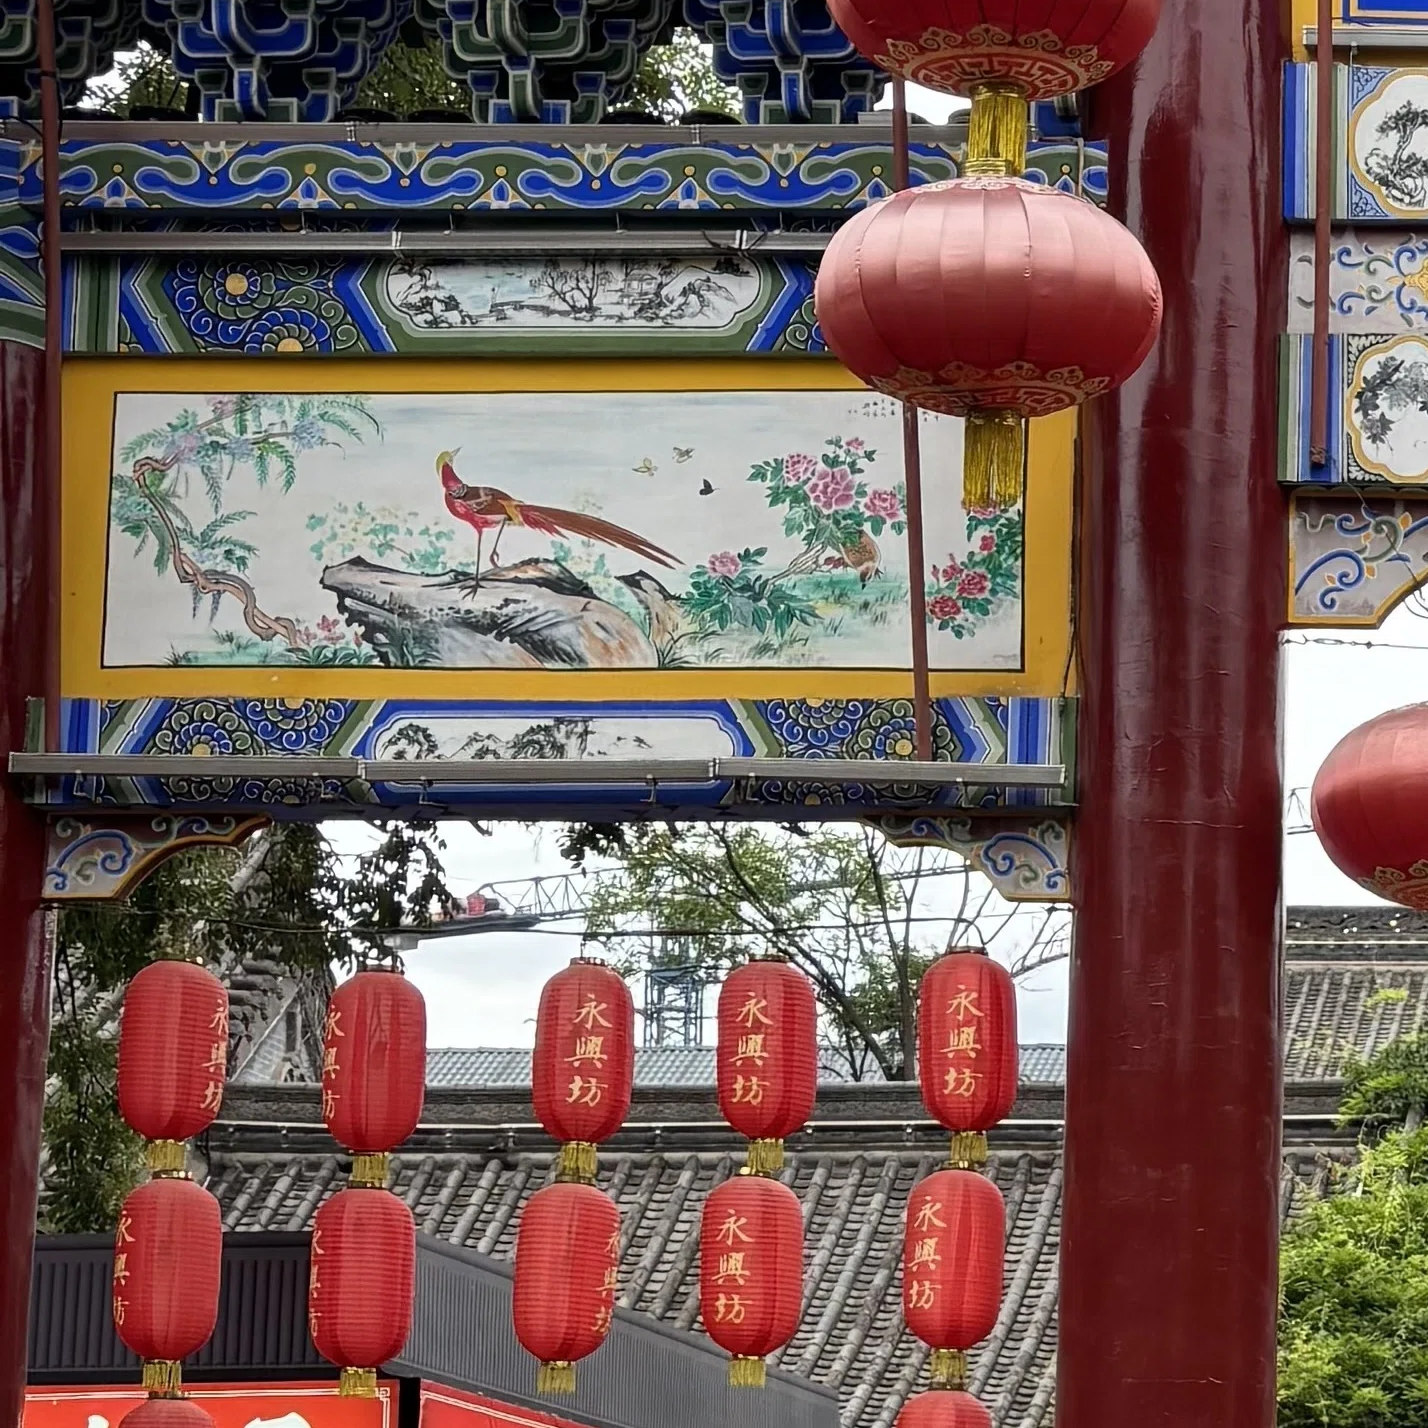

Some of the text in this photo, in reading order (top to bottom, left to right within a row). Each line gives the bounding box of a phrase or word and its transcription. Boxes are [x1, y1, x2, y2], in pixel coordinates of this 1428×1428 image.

[564, 993, 612, 1108] 永興坊
[730, 991, 774, 1106] 永興坊
[939, 984, 985, 1098] 永興坊
[711, 1208, 755, 1324] 永興坊
[908, 1195, 947, 1310] 永興坊
